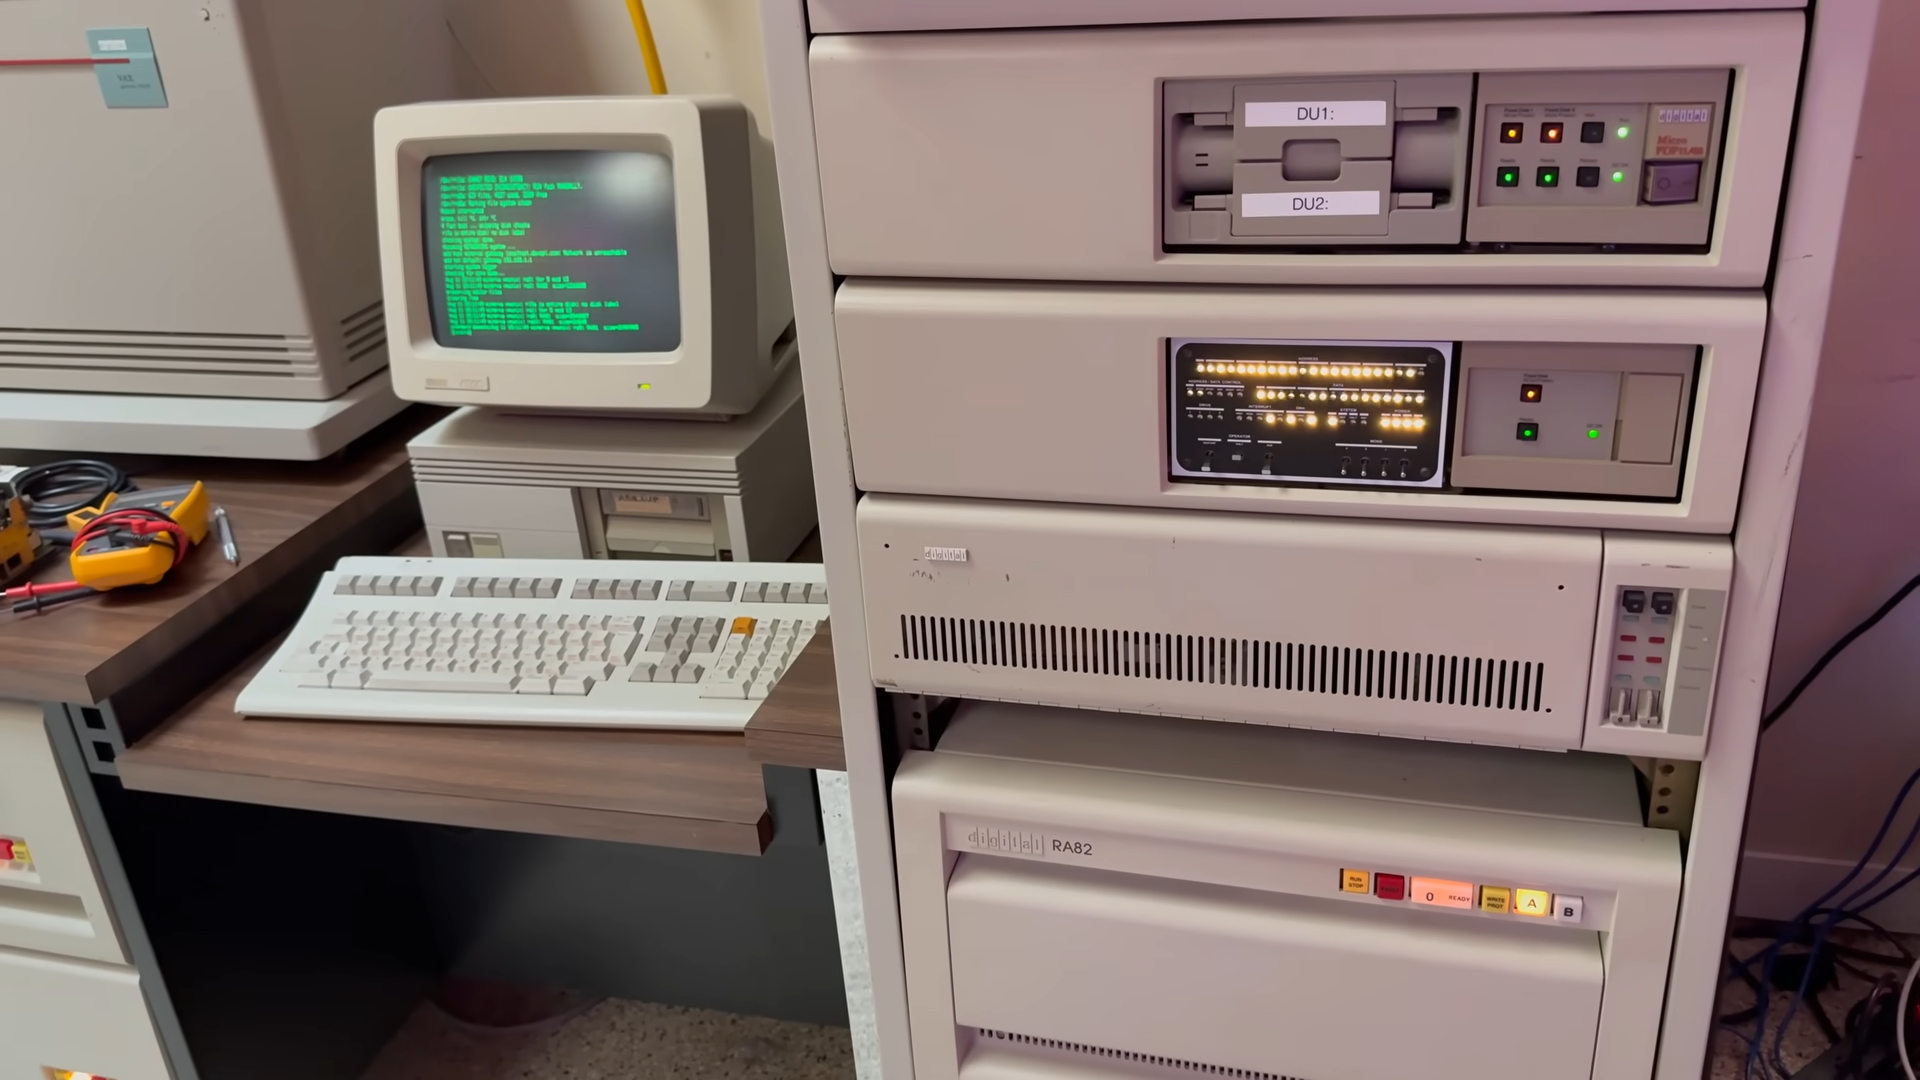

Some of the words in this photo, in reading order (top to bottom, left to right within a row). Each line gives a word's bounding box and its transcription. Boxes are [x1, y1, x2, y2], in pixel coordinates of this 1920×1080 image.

[1297, 107, 1334, 120] DU1:
[1659, 110, 1707, 122] digital
[1657, 135, 1688, 144] Micro
[1292, 197, 1329, 210] DU2:
[924, 546, 967, 561] digital
[968, 830, 1043, 854] digital
[1052, 839, 1093, 856] RA82
[1426, 892, 1434, 902] 0
[1448, 894, 1471, 902] READY
[1527, 898, 1537, 908] A
[1563, 907, 1574, 917] B
